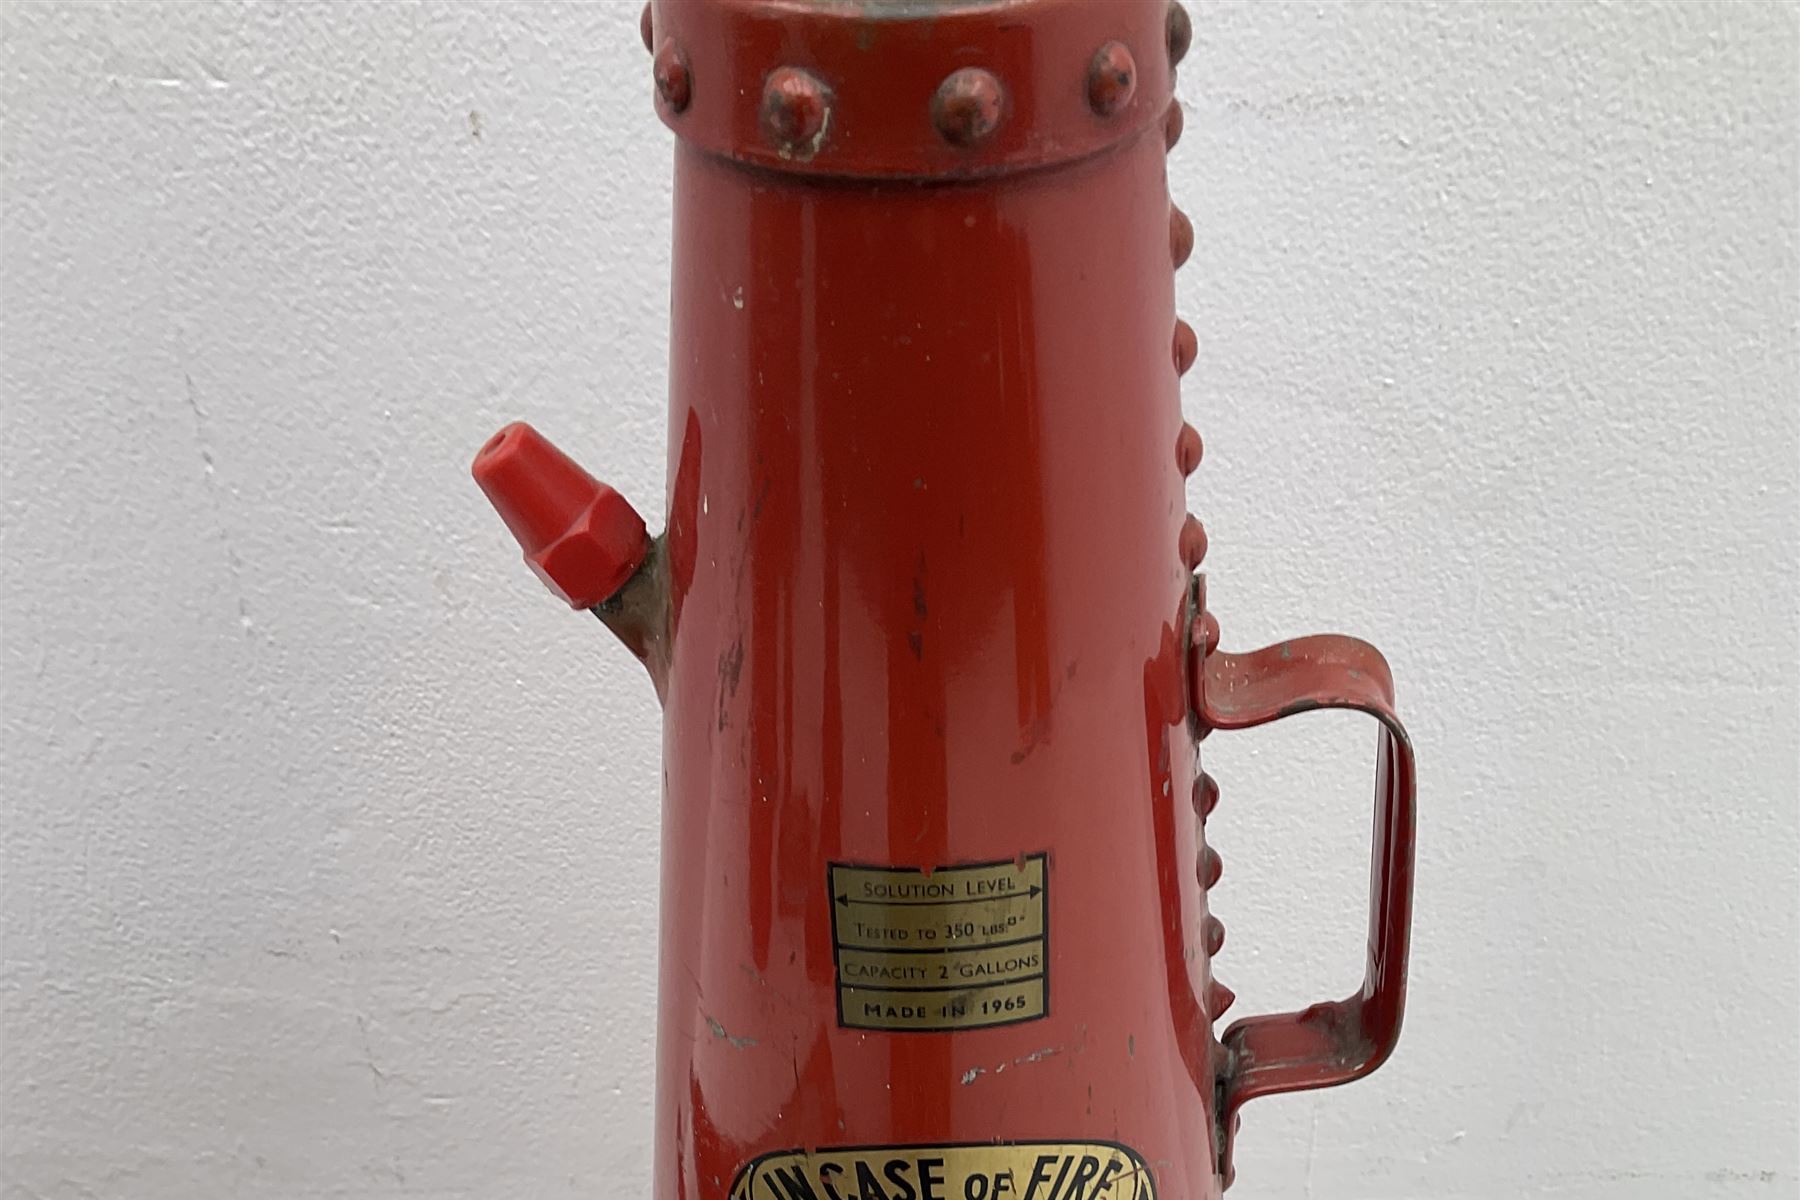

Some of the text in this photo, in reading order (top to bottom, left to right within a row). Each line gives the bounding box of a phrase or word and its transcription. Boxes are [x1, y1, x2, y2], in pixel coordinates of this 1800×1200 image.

[864, 876, 1015, 898] SOLUTION LEVEL
[854, 922, 908, 940] TESTED
[918, 929, 936, 940] TO
[845, 955, 1039, 980] CAPACITY 2 GALLONS
[864, 995, 1026, 1019] MADE IN 1965
